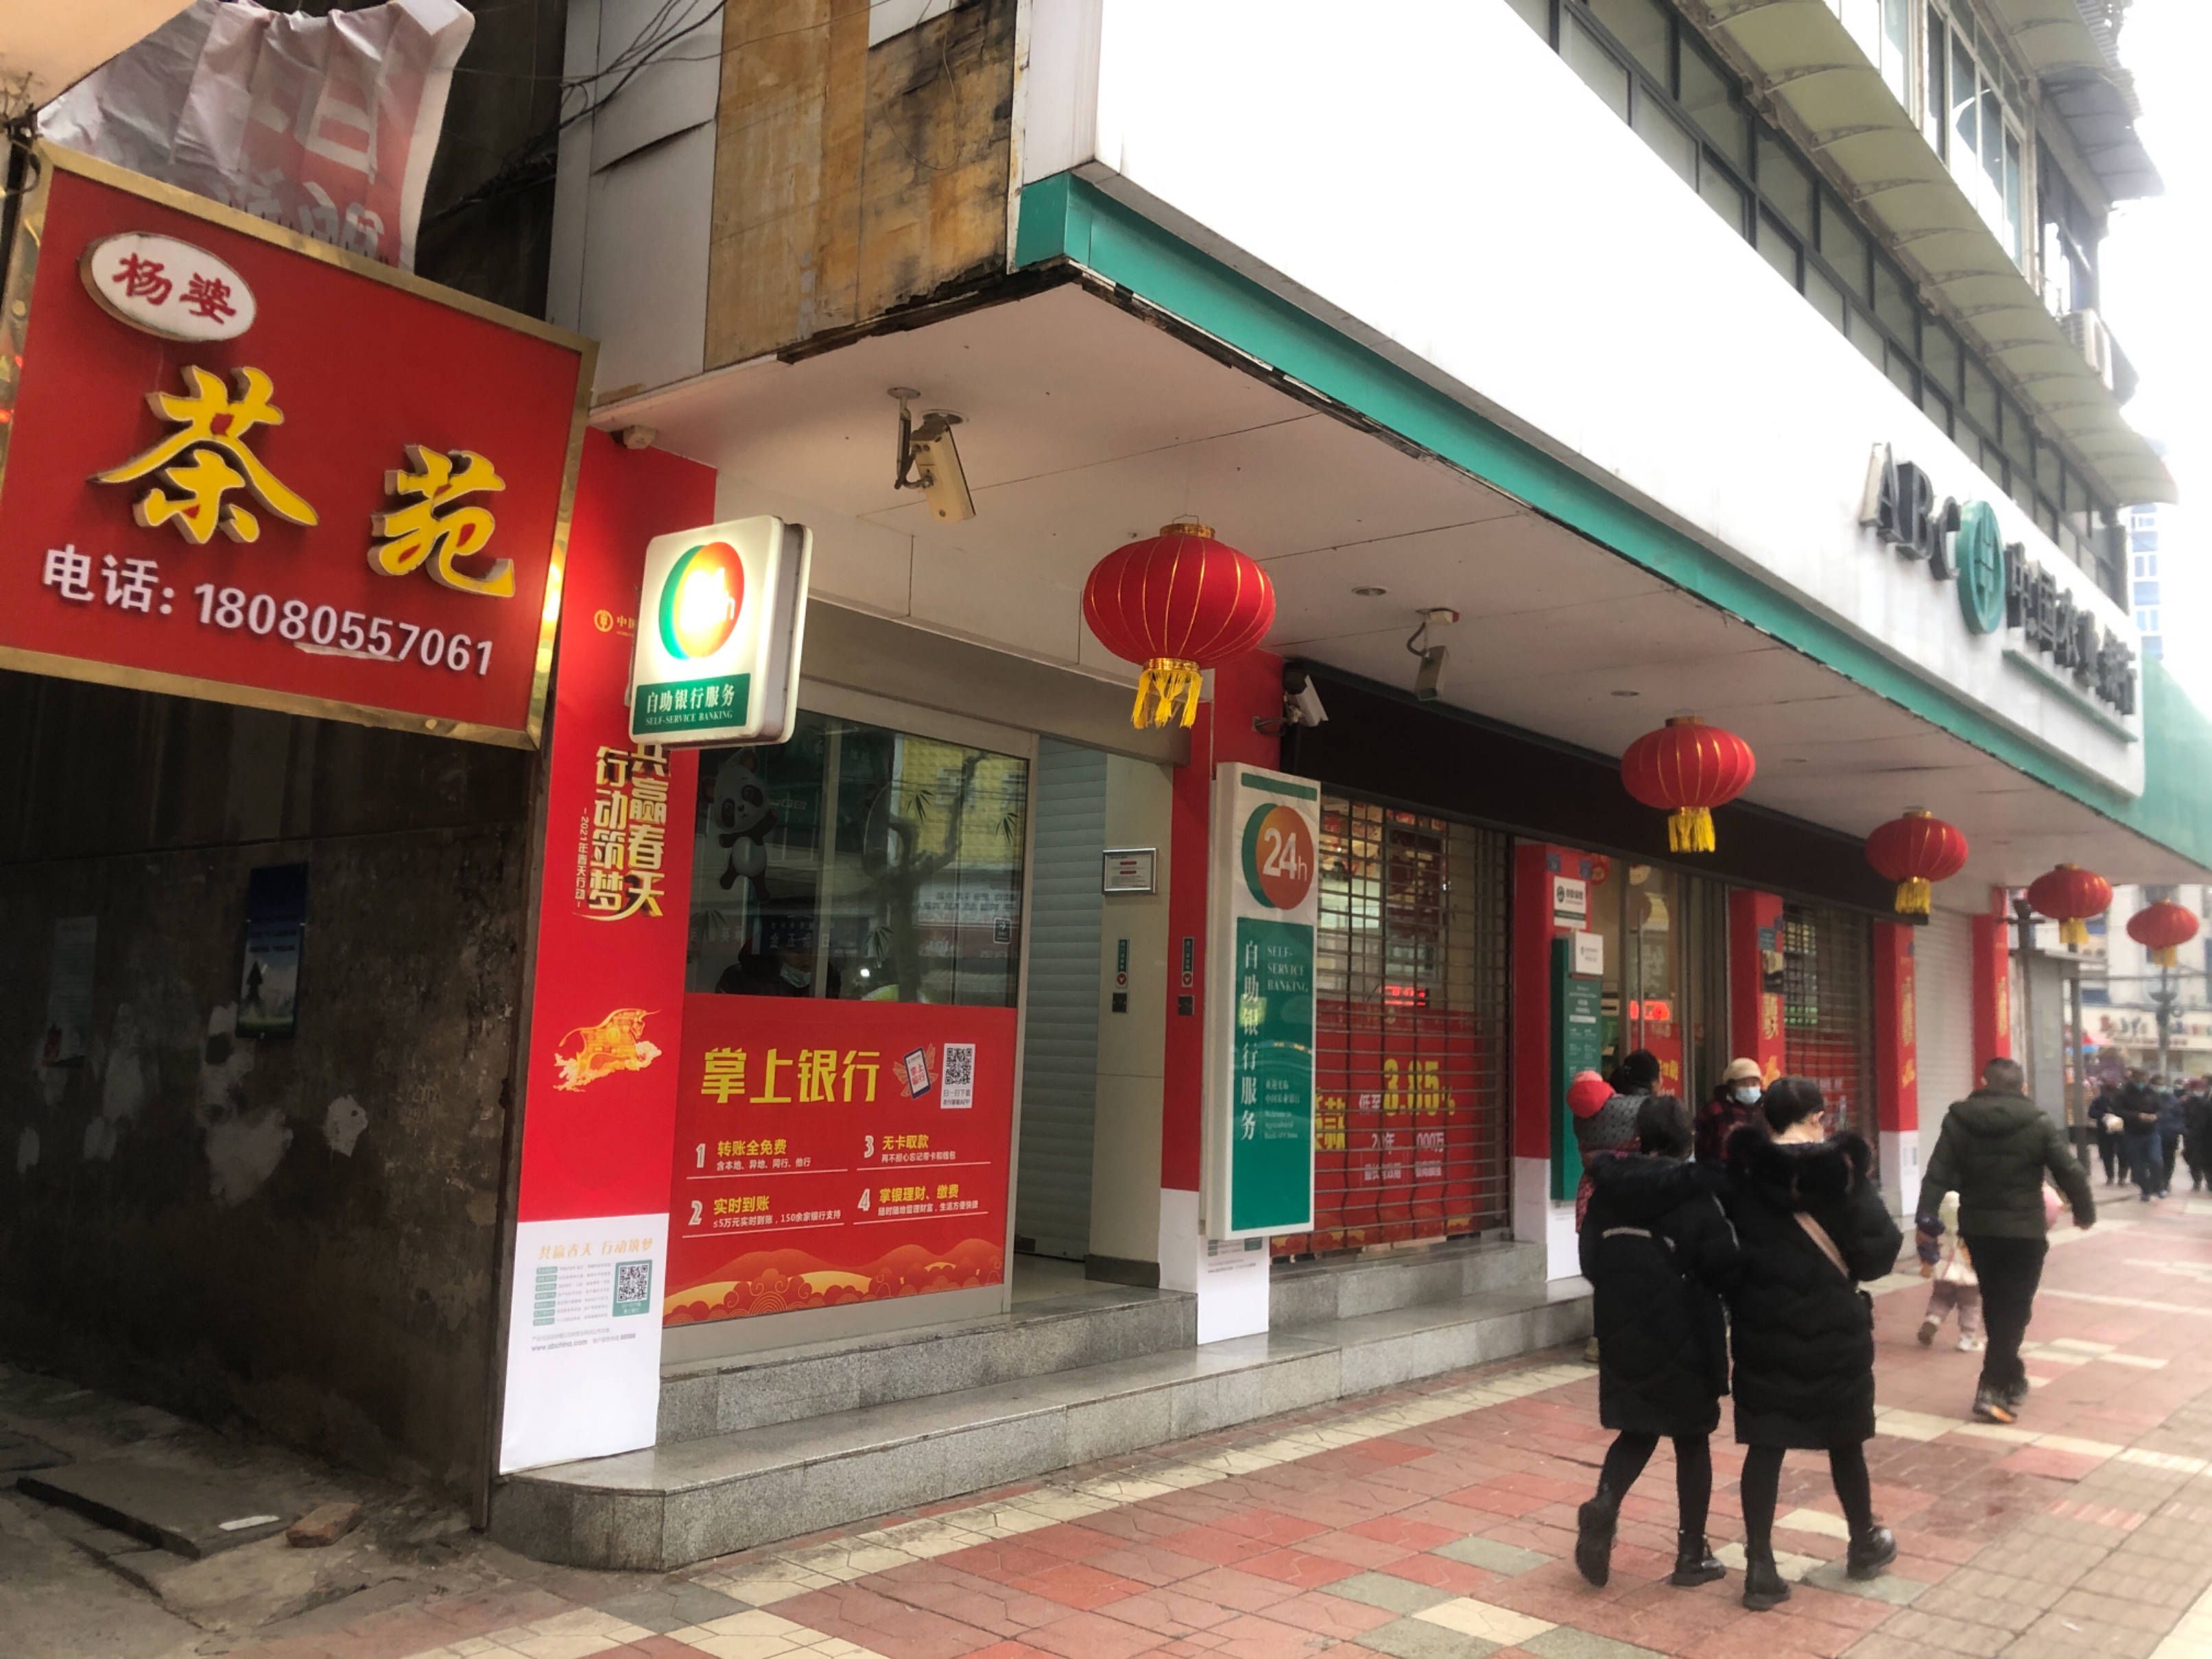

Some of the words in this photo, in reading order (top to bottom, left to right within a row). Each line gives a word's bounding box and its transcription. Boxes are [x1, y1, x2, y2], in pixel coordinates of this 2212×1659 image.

[112, 252, 237, 325] 杨婆
[86, 365, 516, 598] 茶苑
[1859, 442, 1962, 580] ABC
[193, 583, 493, 676] 18080557061
[647, 683, 735, 714] 自助银行服务
[646, 713, 697, 725] SELF-SERVICE
[699, 711, 733, 721] BANKING
[588, 745, 629, 911] 行动筑梦
[1263, 827, 1307, 882] 24h
[1240, 940, 1259, 1141] 自助银行服务
[701, 1047, 880, 1103] 掌上银行
[695, 1143, 706, 1168] 1
[717, 1138, 787, 1158] 转账全免费
[864, 1135, 875, 1158] 3
[882, 1134, 929, 1150] 无卡取款
[688, 1200, 704, 1226] 2
[713, 1195, 770, 1215] 实时到账
[858, 1189, 870, 1212] 4
